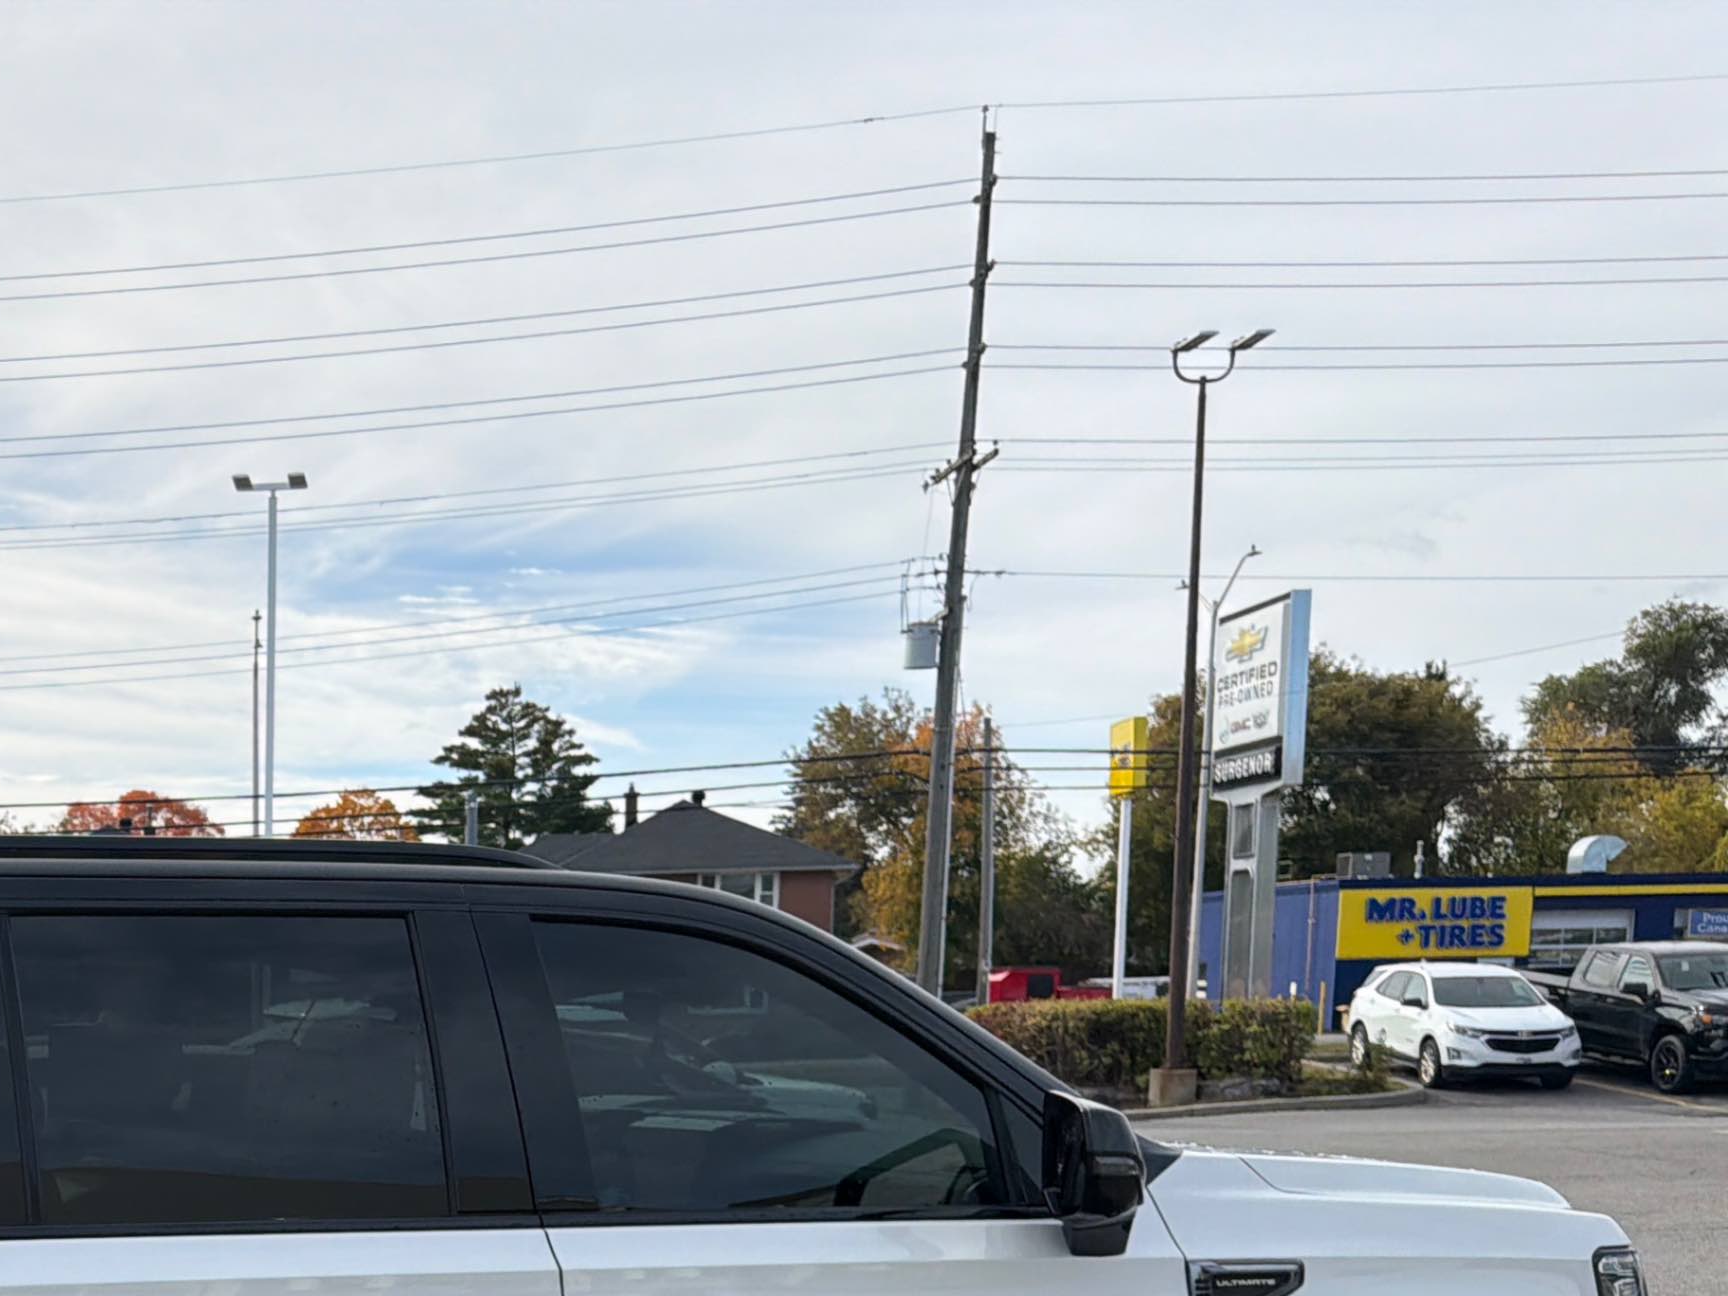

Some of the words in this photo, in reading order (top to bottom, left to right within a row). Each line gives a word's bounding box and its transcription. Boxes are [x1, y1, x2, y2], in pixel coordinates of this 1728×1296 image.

[1217, 661, 1278, 693] CERTIFIED
[1217, 680, 1273, 709] PRE-OWNED
[1365, 898, 1427, 922] MR.
[1431, 896, 1507, 921] LUBE
[1216, 1278, 1276, 1287] ULTIMATE
